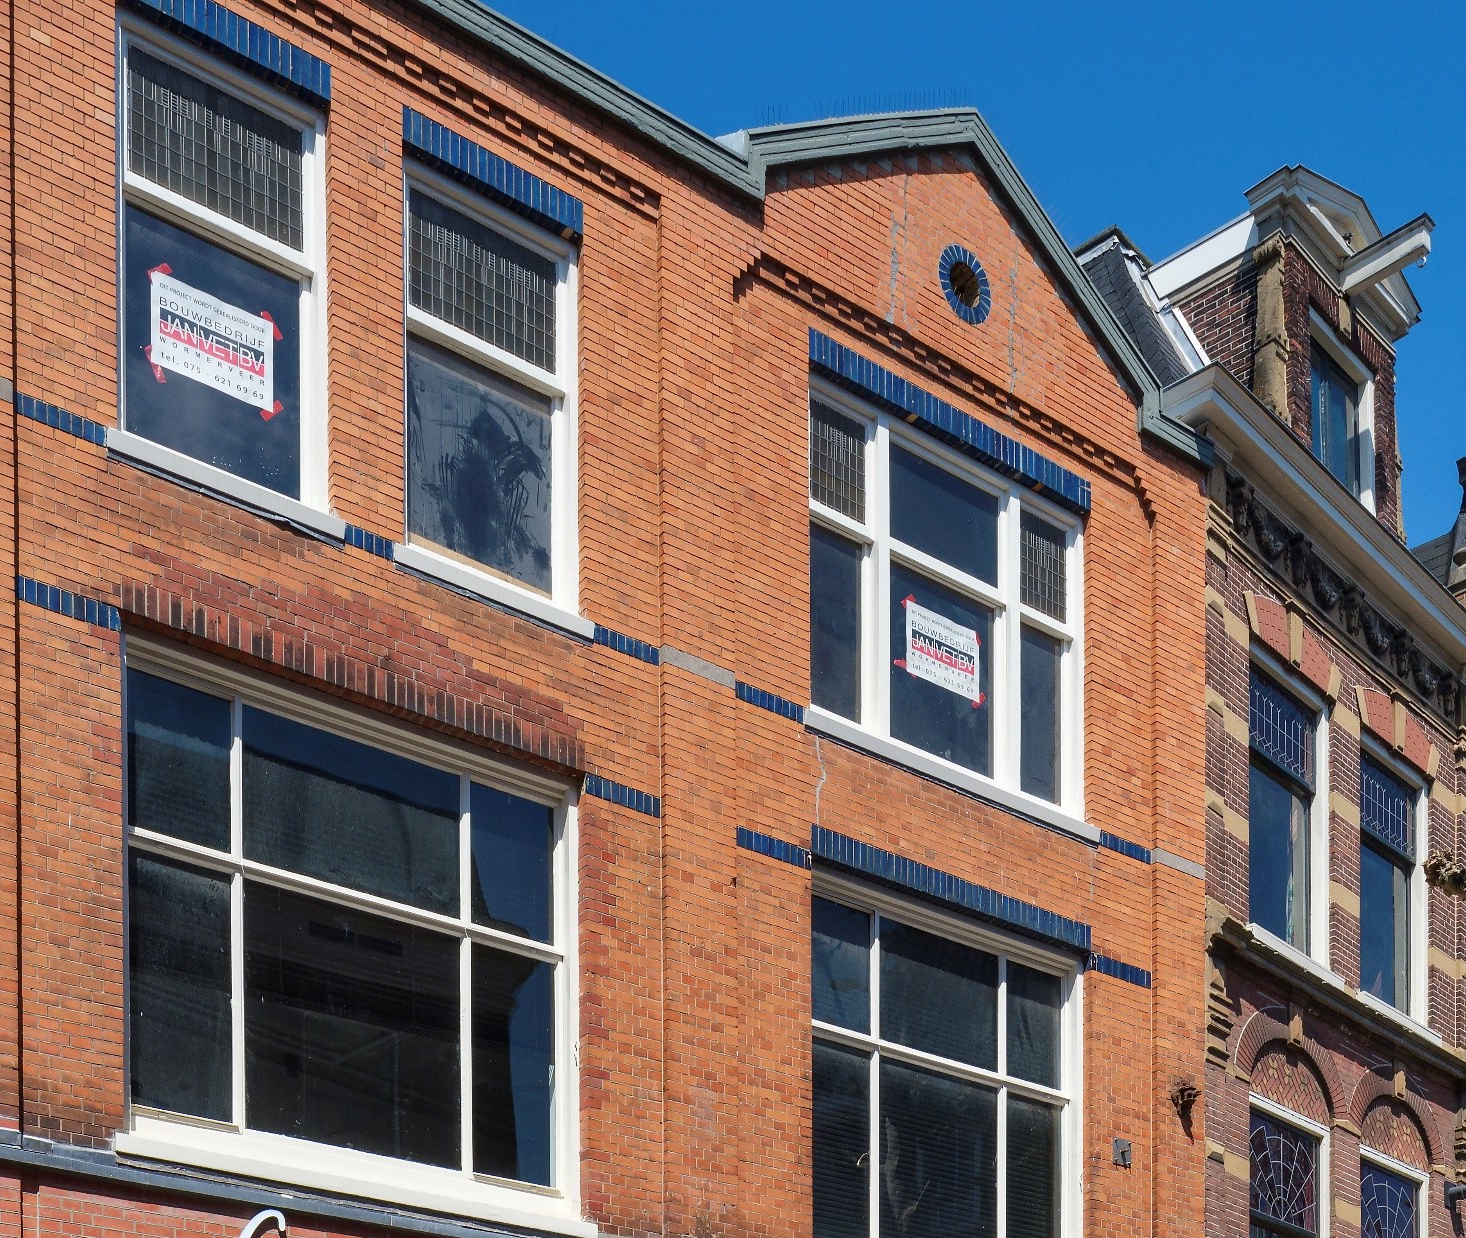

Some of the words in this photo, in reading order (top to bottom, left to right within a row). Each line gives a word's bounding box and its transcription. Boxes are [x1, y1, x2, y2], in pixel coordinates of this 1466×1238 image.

[159, 282, 169, 291] DIT
[169, 287, 192, 301] PROJECT
[192, 298, 212, 310] WORDT
[159, 296, 265, 348] BOUWBEDRIJF
[160, 314, 197, 345] JAN
[200, 329, 238, 360] VET
[240, 346, 264, 371] BV
[159, 335, 265, 386] WORMERVEER
[161, 352, 179, 365] tel.
[183, 361, 201, 374] 075
[214, 374, 231, 387] 621
[236, 384, 248, 394] 69
[252, 390, 264, 400] 69
[912, 620, 975, 653] BOUWBEDRIJF
[913, 633, 934, 655] JAN
[936, 642, 958, 665] VET
[958, 654, 974, 671] BV
